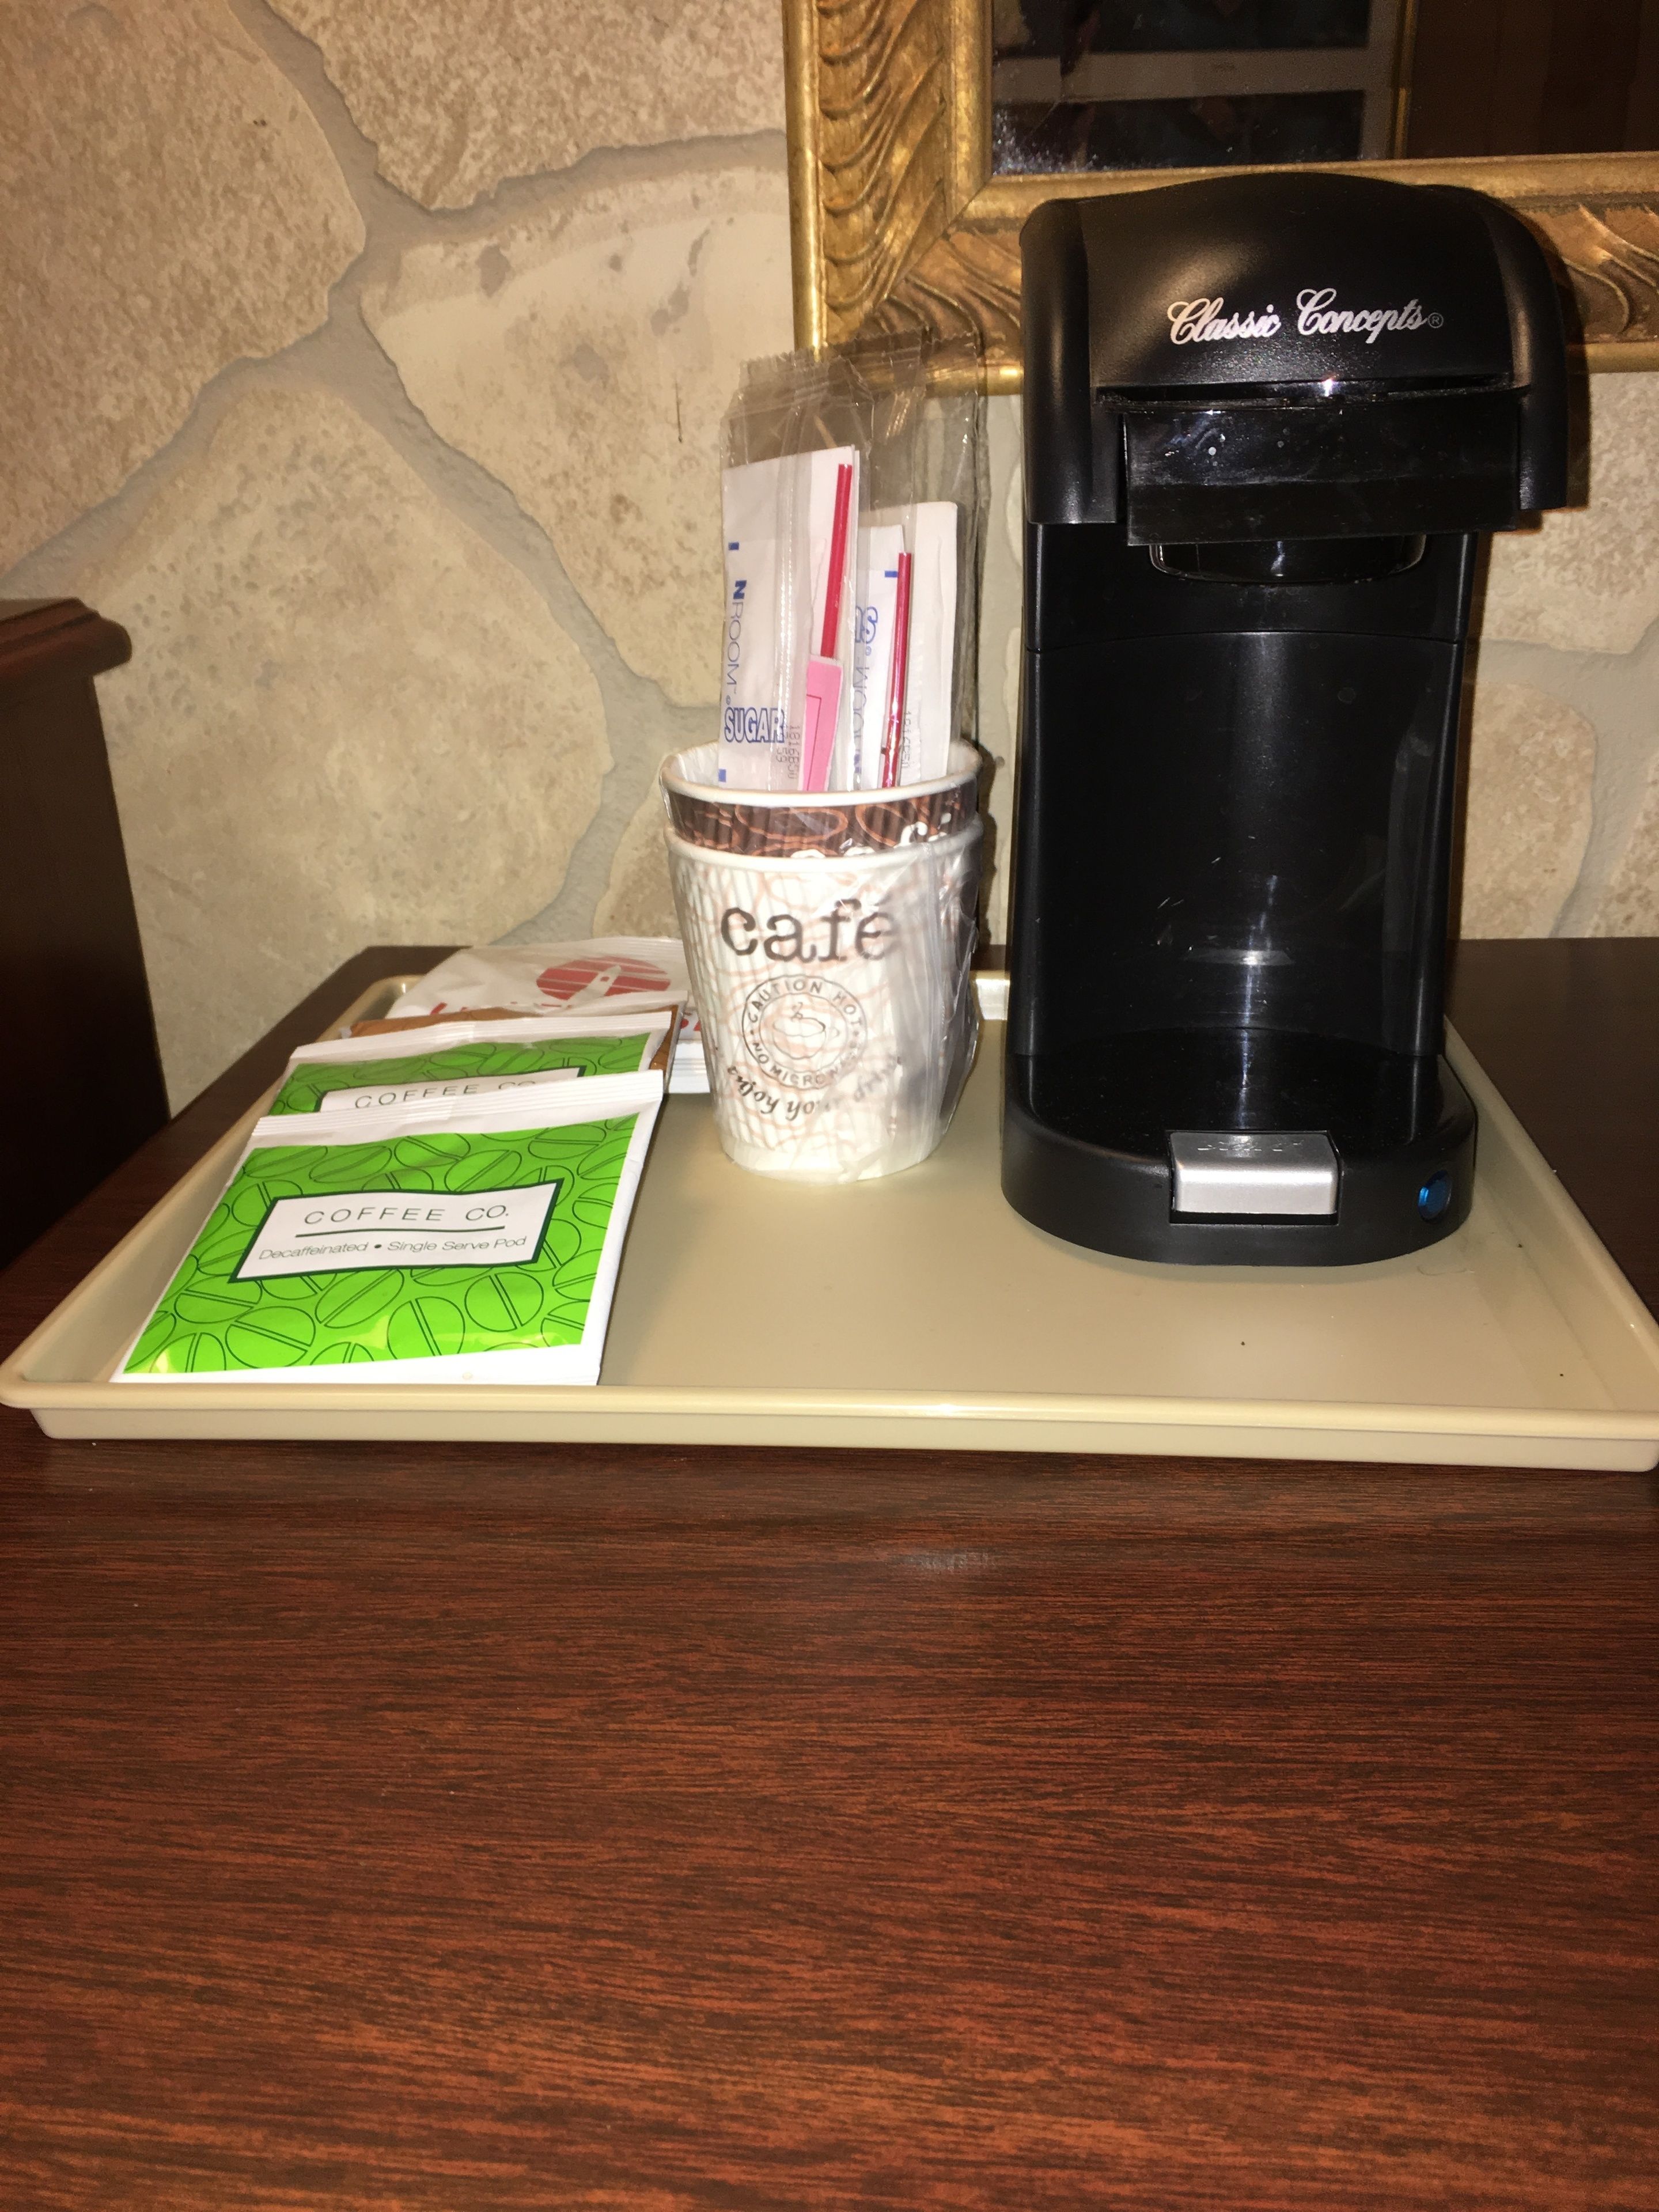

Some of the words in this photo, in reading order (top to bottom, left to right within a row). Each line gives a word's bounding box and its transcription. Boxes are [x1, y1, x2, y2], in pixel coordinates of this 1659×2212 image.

[1167, 297, 1282, 345] Classic
[724, 706, 785, 743] SUGAR
[748, 979, 823, 1024] CAUTION
[832, 991, 863, 1026] HOT
[752, 1042, 770, 1065] NO
[355, 1084, 480, 1109] COFFEE
[727, 1065, 780, 1115] enjoy
[304, 1206, 446, 1225] COFFEE
[258, 1241, 369, 1260] Decaffeinated
[387, 1240, 437, 1253] Single
[441, 1240, 490, 1252] Serve
[494, 1236, 528, 1249] Pod
